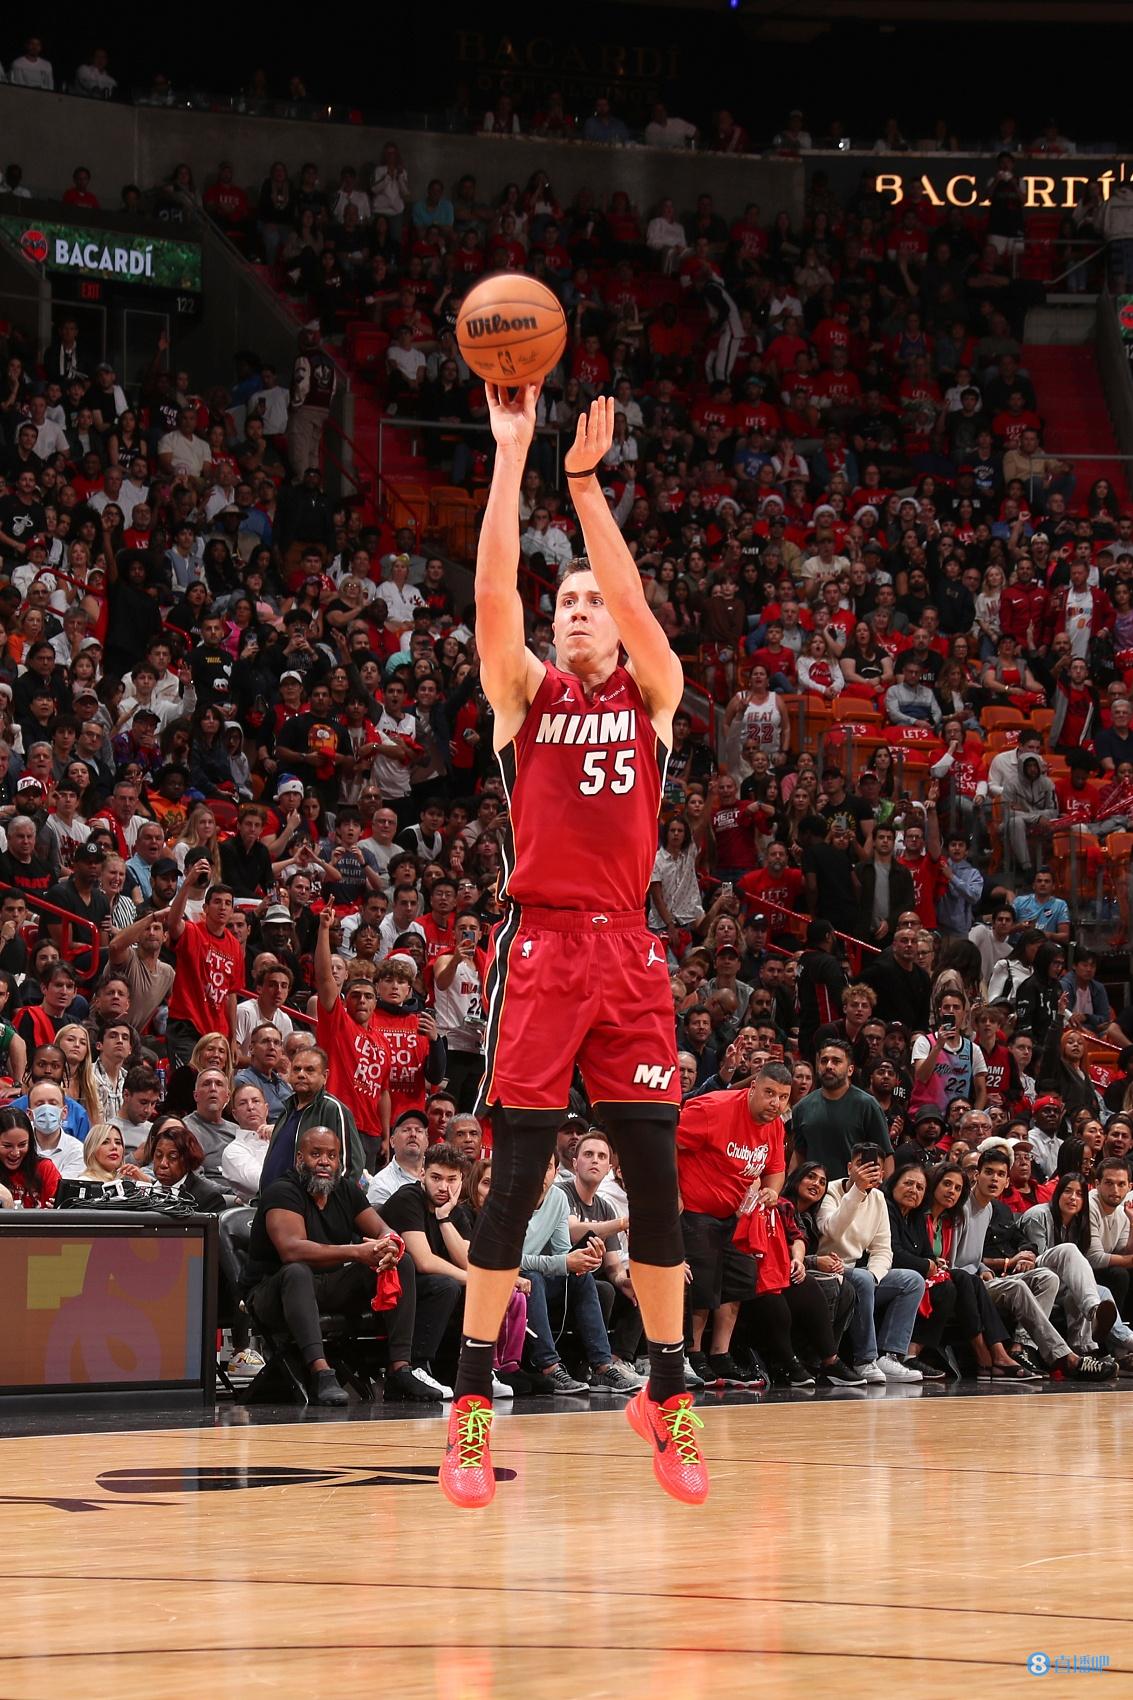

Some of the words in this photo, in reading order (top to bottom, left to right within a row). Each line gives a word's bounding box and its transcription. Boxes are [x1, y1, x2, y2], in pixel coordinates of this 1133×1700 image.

[875, 170, 1116, 208] BACRDÍ
[54, 238, 154, 278] BACARDÍ
[748, 711, 773, 721] HEAT
[535, 708, 637, 745] MIAMI
[747, 723, 775, 744] 22
[902, 729, 929, 740] LET'S
[579, 749, 638, 796] 55
[383, 1032, 417, 1049] ET'S
[389, 1065, 419, 1083] EAT
[985, 1075, 1002, 1088] 22
[944, 1077, 967, 1094] 22
